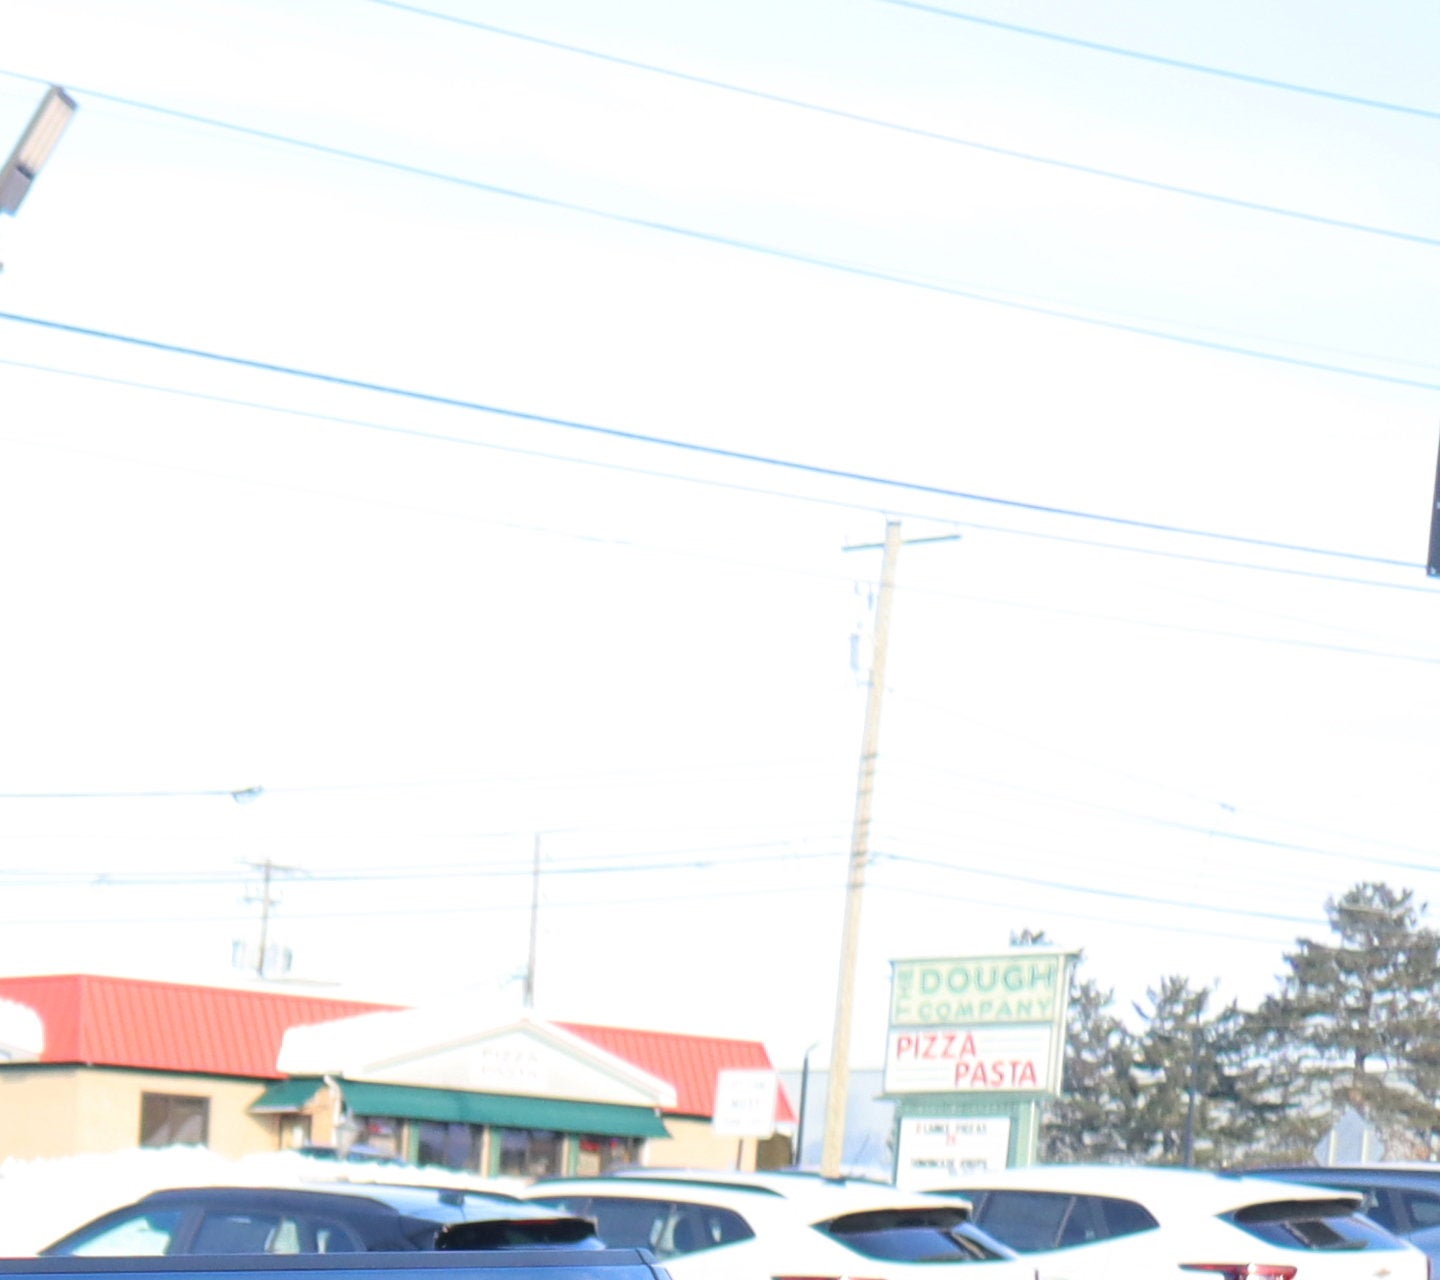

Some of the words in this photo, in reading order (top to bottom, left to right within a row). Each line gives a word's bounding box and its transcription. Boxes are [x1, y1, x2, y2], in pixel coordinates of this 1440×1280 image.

[920, 964, 1054, 994] DOUGH
[919, 998, 1051, 1021] COMPANY
[896, 1033, 977, 1060] PIZZA
[954, 1060, 1038, 1088] PASTA
